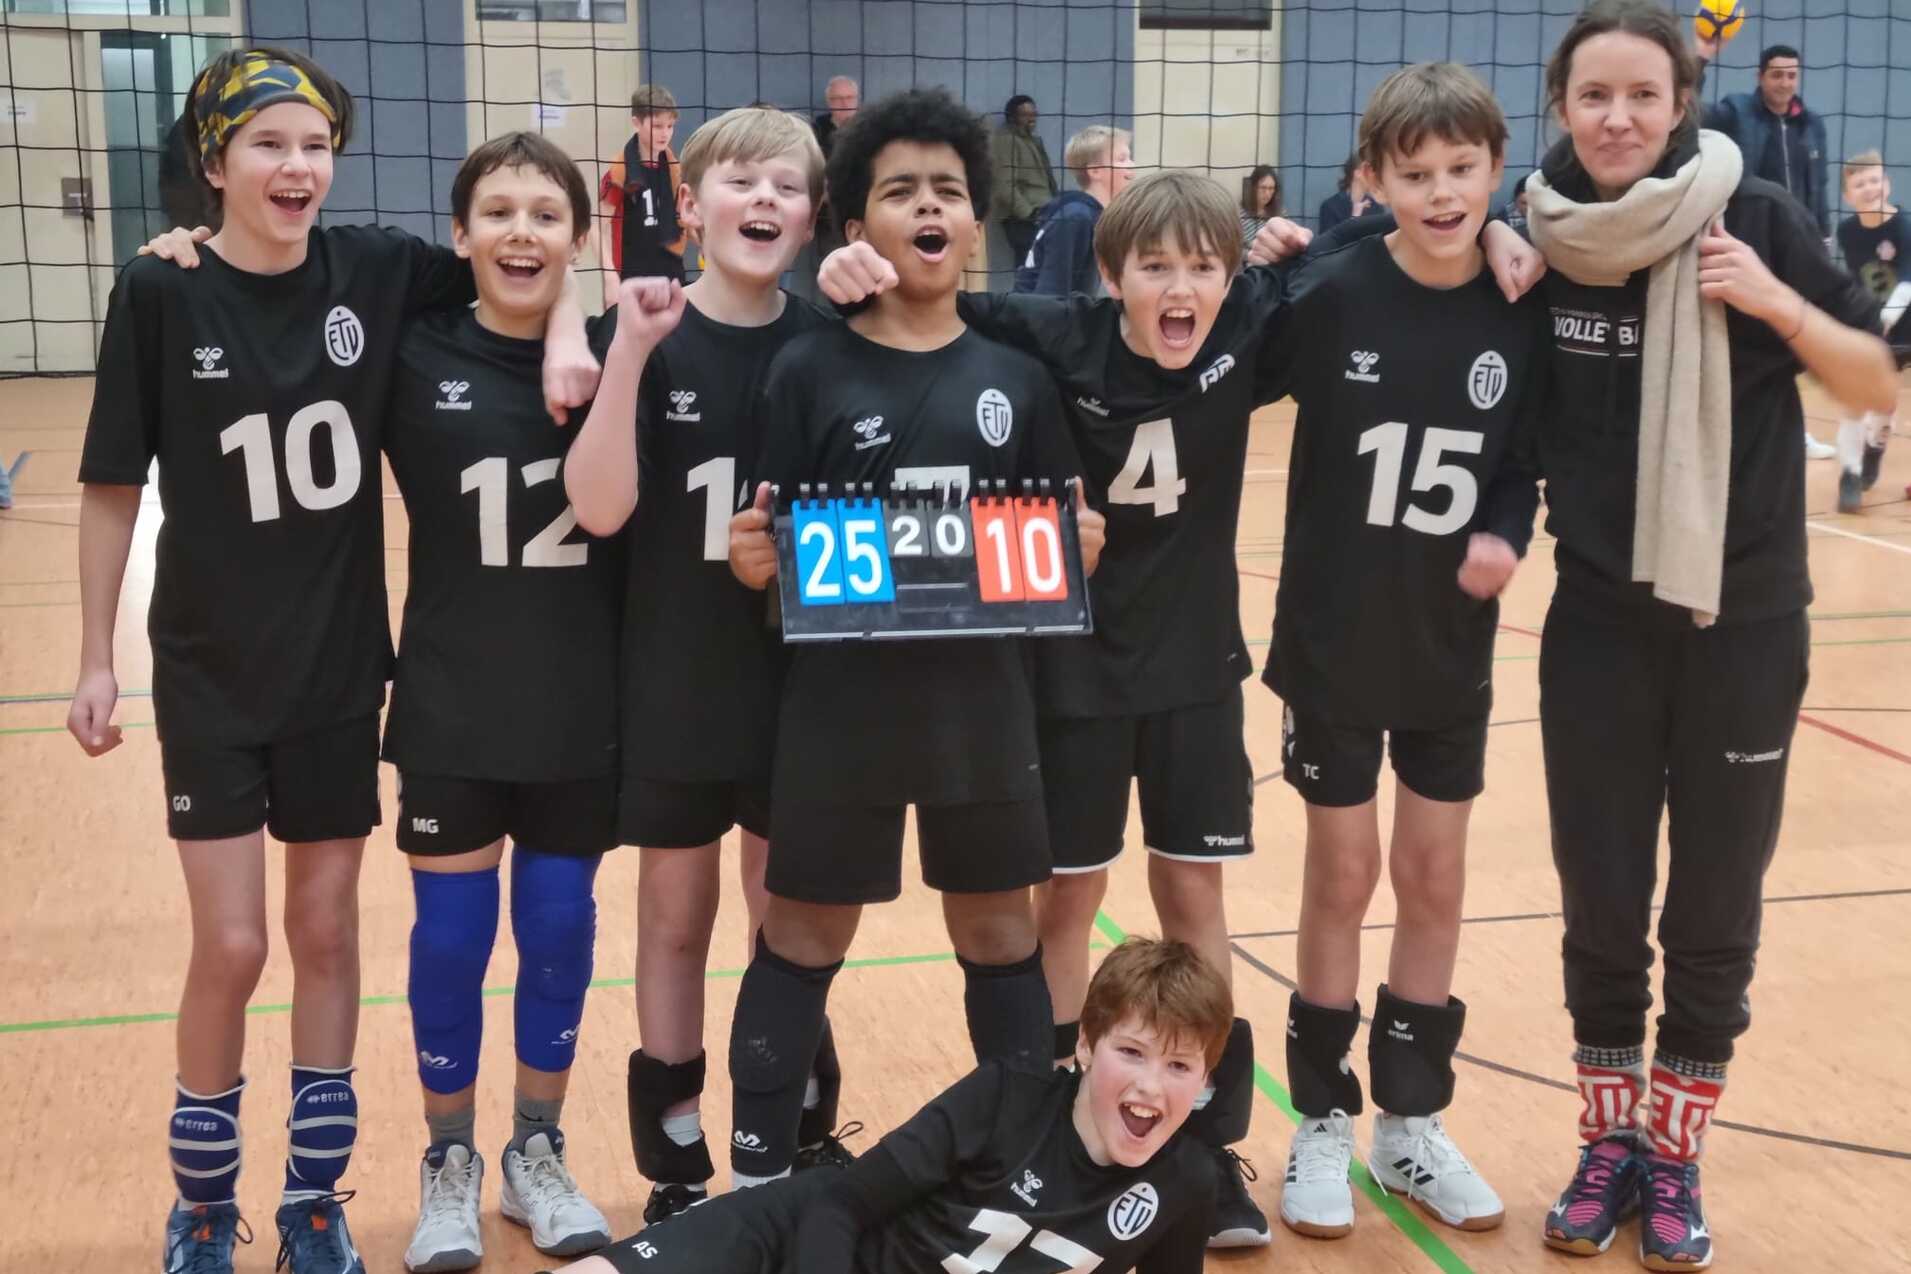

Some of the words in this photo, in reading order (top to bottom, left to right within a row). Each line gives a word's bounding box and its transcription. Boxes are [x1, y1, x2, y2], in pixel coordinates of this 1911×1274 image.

[1554, 315, 1611, 345] VOLLE
[219, 400, 362, 523] 10
[1107, 417, 1187, 518] 4
[1357, 421, 1485, 536] 15
[460, 456, 589, 568] 12
[799, 519, 883, 598] 25
[985, 517, 1063, 594] 10
[1302, 763, 1320, 780] TC
[172, 795, 192, 812] GO
[412, 817, 439, 834] MG
[631, 1240, 659, 1260] AS
